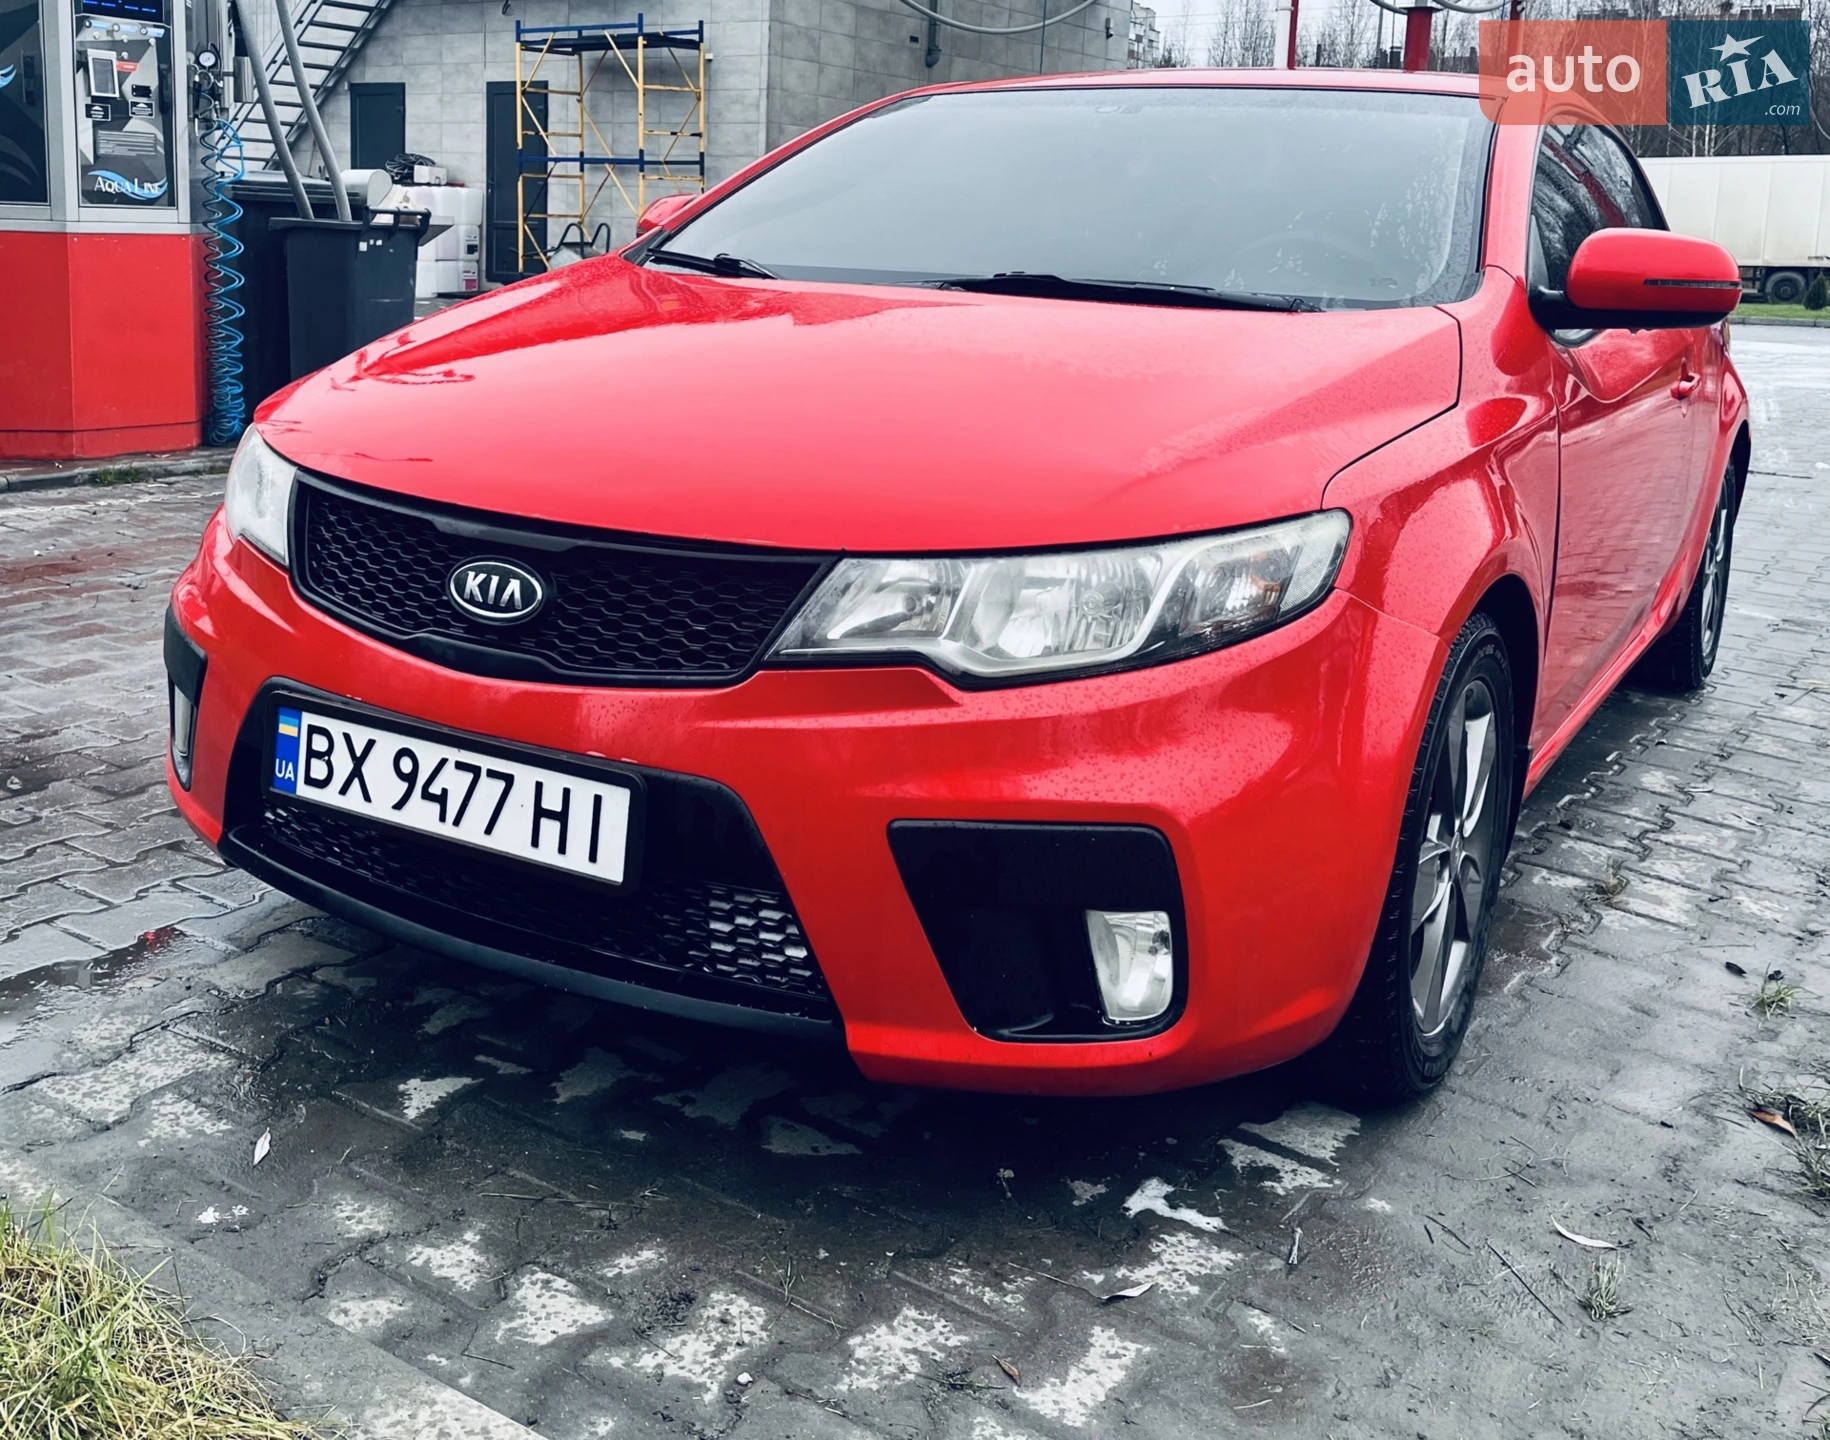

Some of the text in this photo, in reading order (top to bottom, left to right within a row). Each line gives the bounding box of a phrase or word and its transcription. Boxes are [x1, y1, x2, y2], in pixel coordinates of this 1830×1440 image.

[463, 570, 522, 610] KIA
[275, 758, 295, 781] UA
[304, 724, 603, 864] BX 9477 HI
